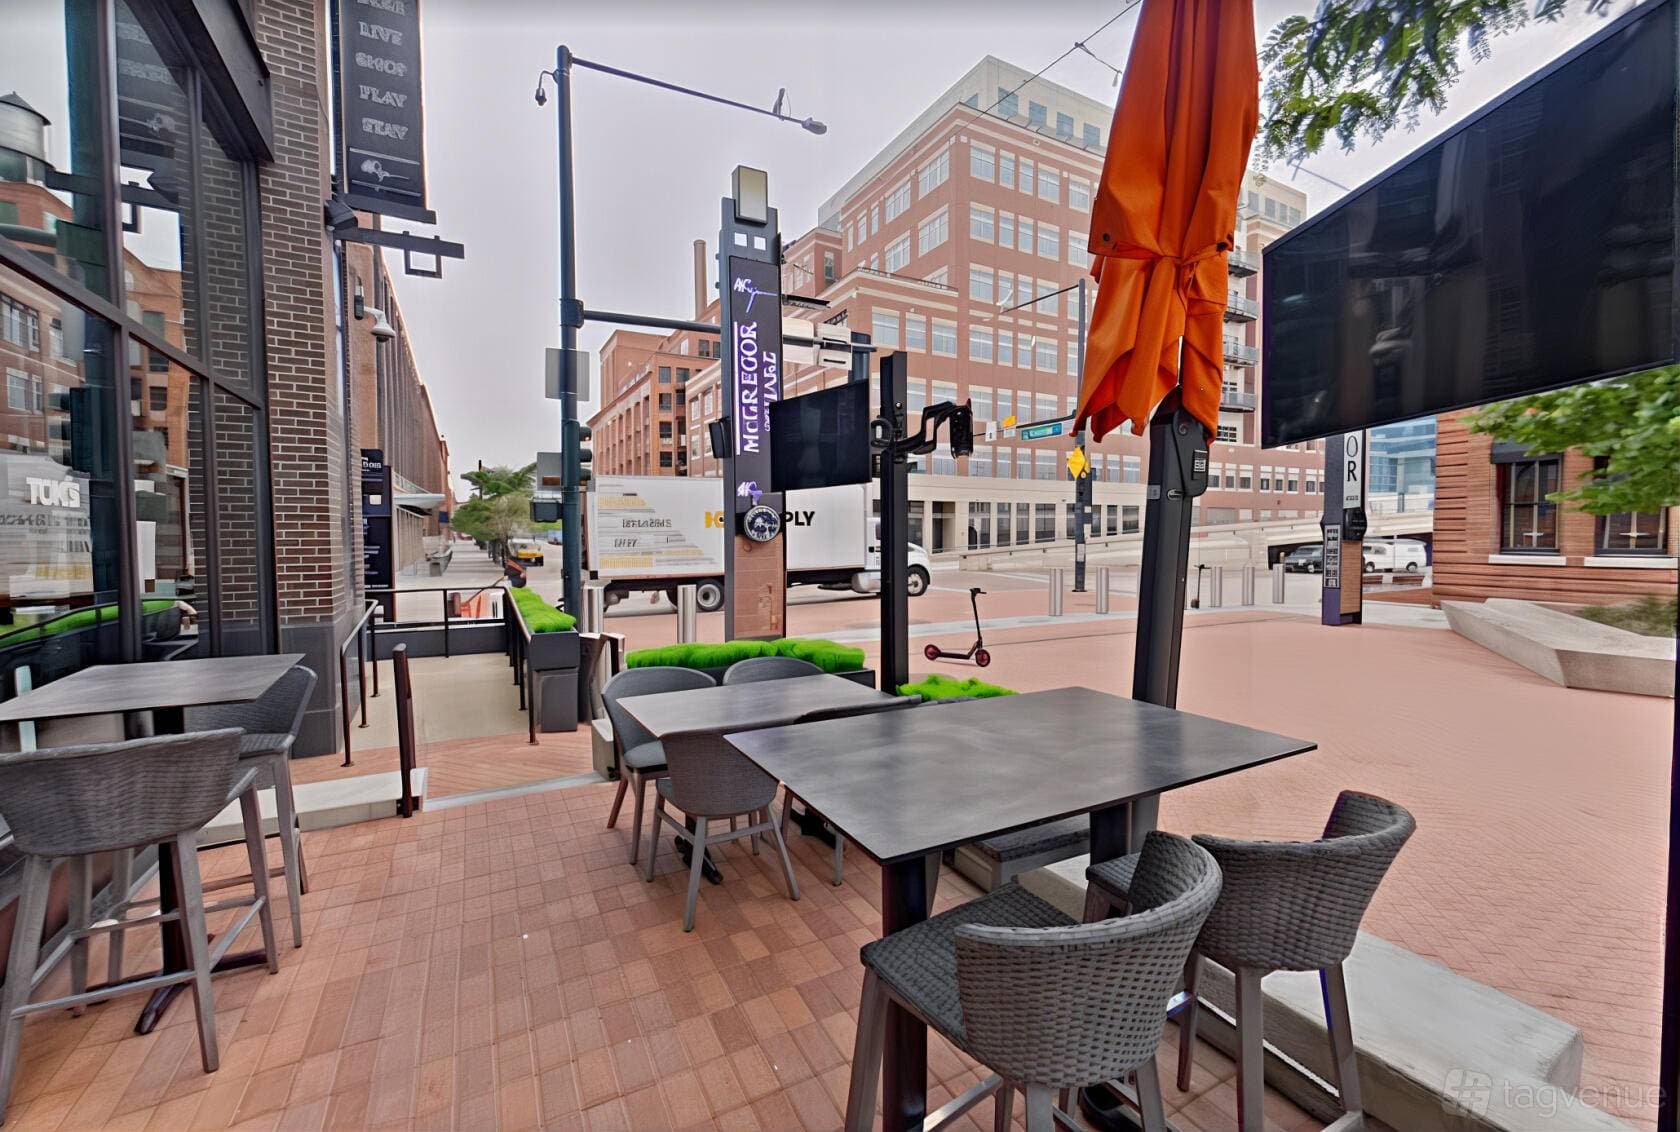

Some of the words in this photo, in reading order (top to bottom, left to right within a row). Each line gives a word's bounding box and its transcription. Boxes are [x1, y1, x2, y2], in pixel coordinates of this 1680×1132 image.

[358, 21, 403, 46] LIVE
[358, 84, 408, 108] PLAY
[785, 510, 816, 527] PLY
